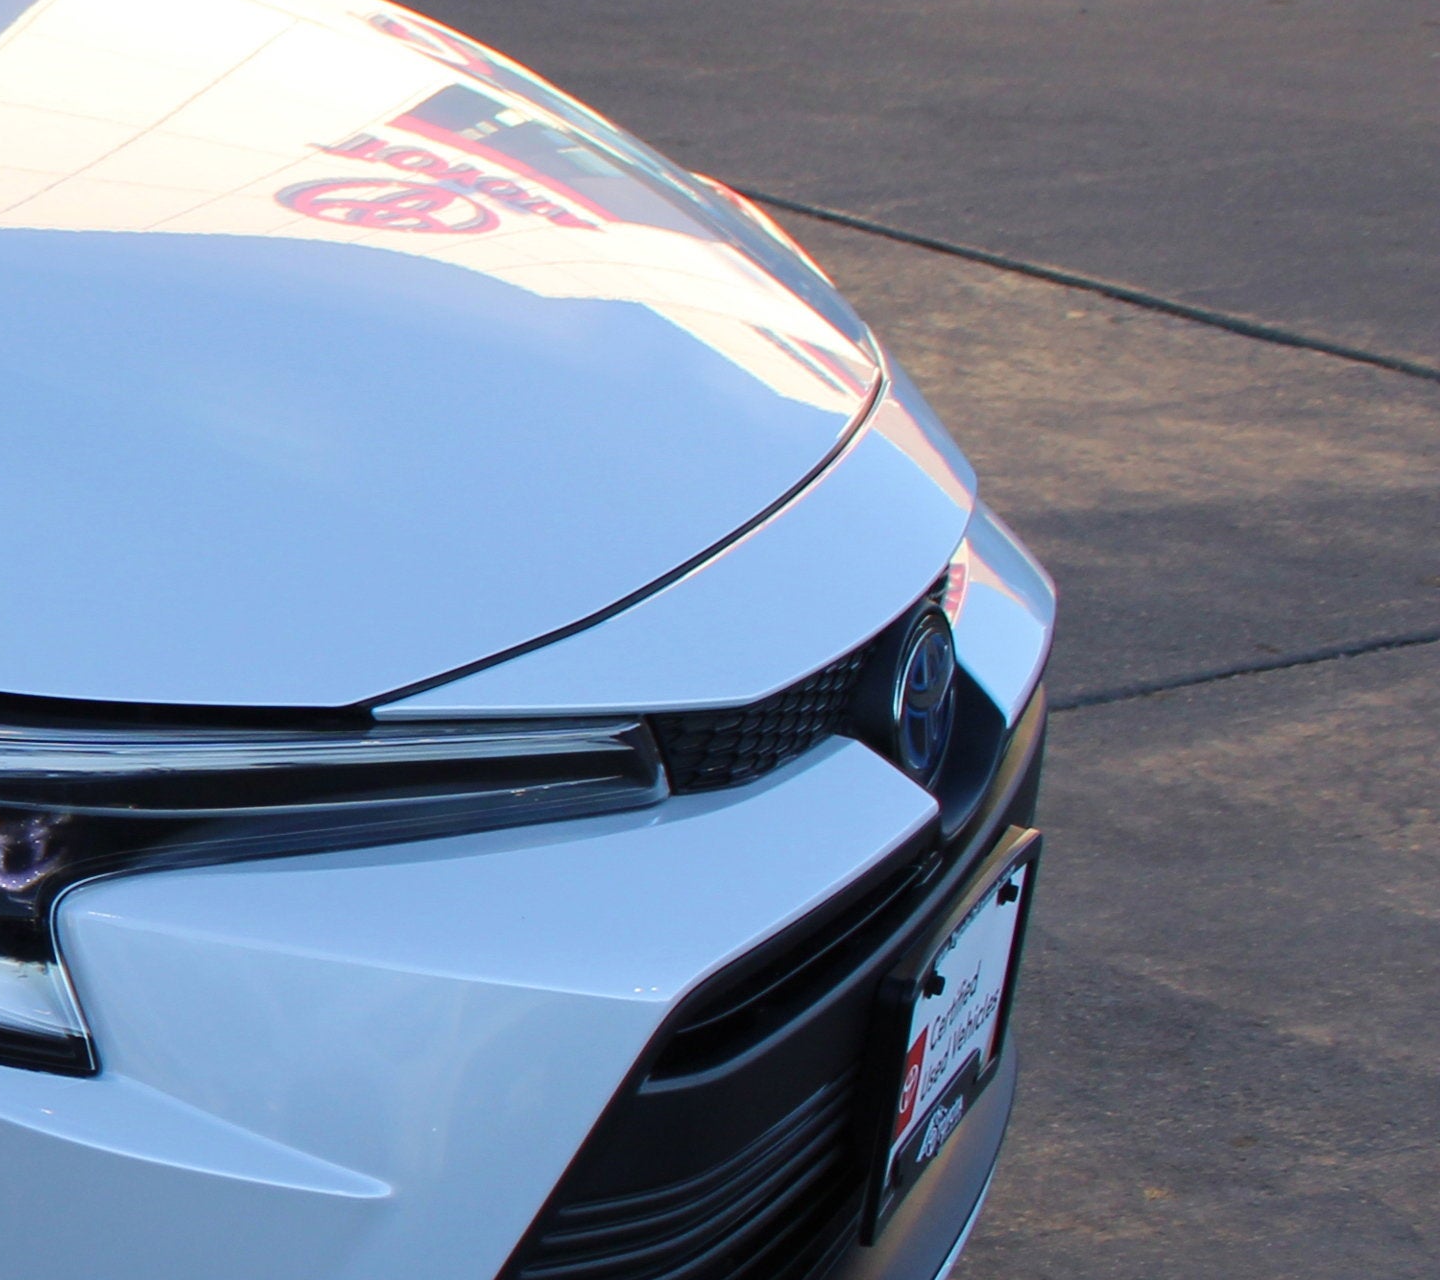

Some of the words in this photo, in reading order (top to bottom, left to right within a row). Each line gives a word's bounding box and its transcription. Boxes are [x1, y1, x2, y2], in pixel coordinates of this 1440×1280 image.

[919, 1035, 953, 1102] Used
[950, 987, 1001, 1059] Vehicles
[930, 959, 982, 1051] Certified
